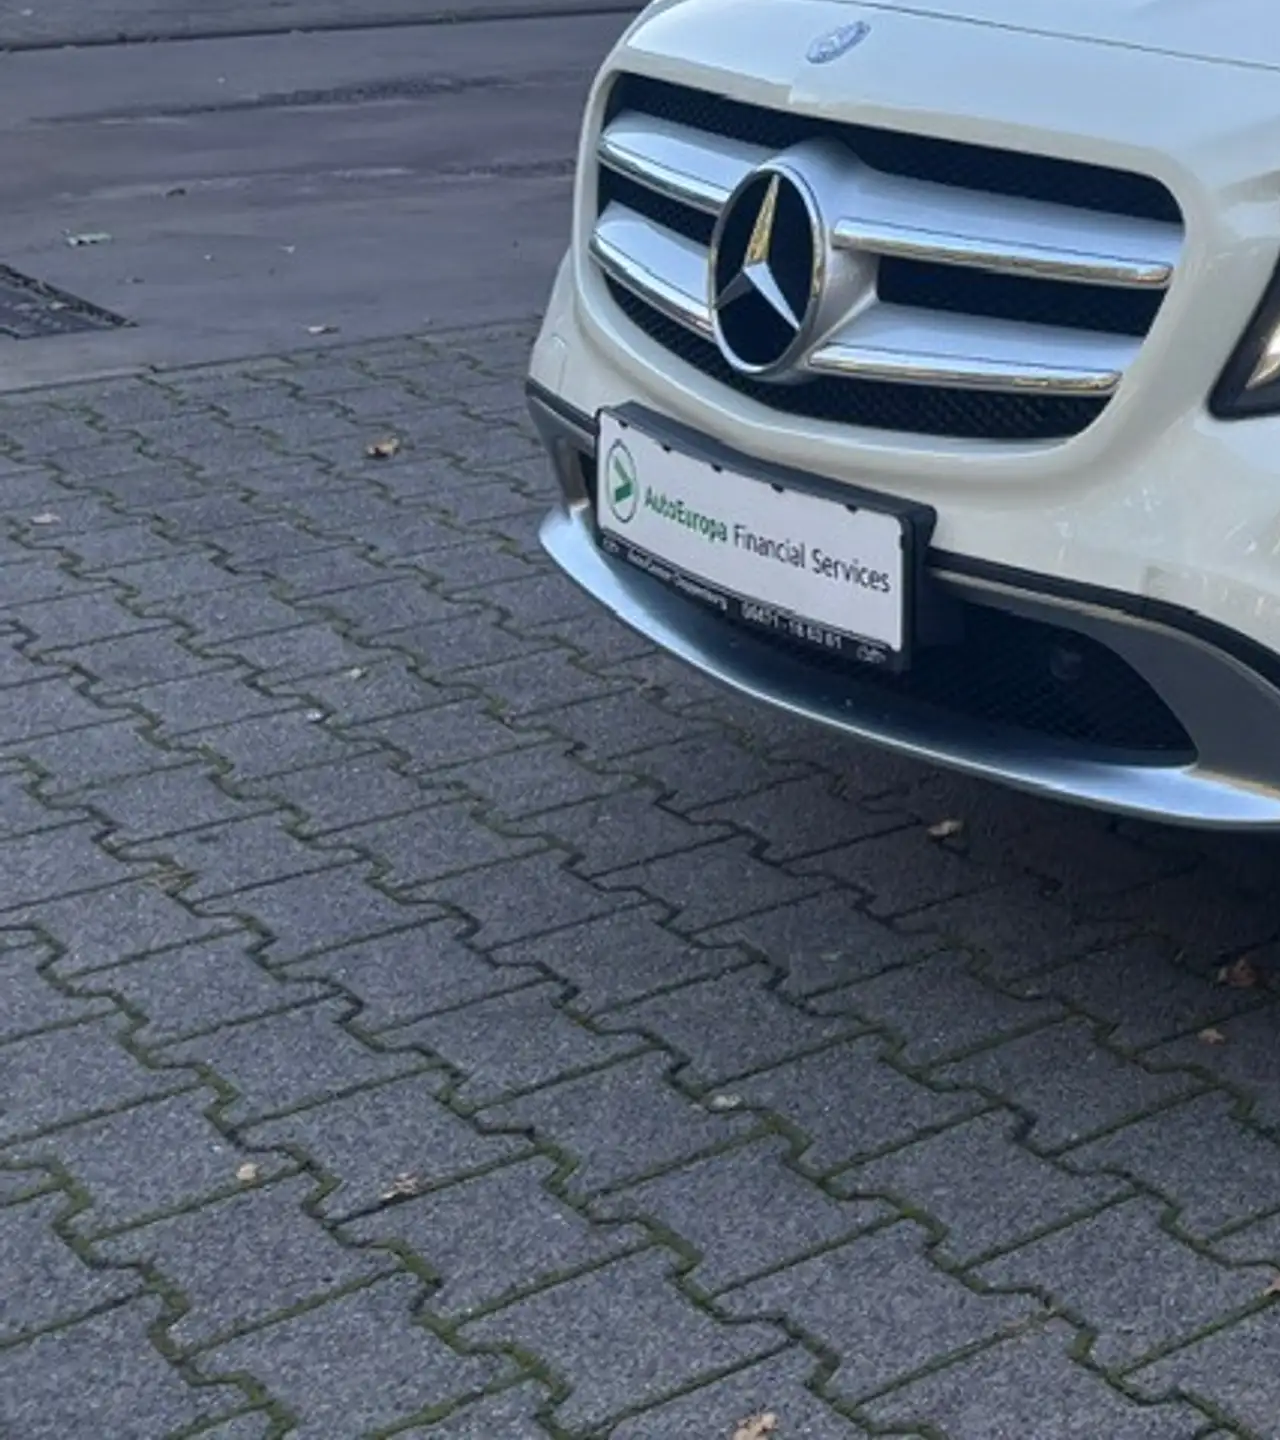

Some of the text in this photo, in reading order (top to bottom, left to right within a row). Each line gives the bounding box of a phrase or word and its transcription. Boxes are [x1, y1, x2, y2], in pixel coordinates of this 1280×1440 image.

[643, 486, 891, 593] AutoEuropa Financial Services
